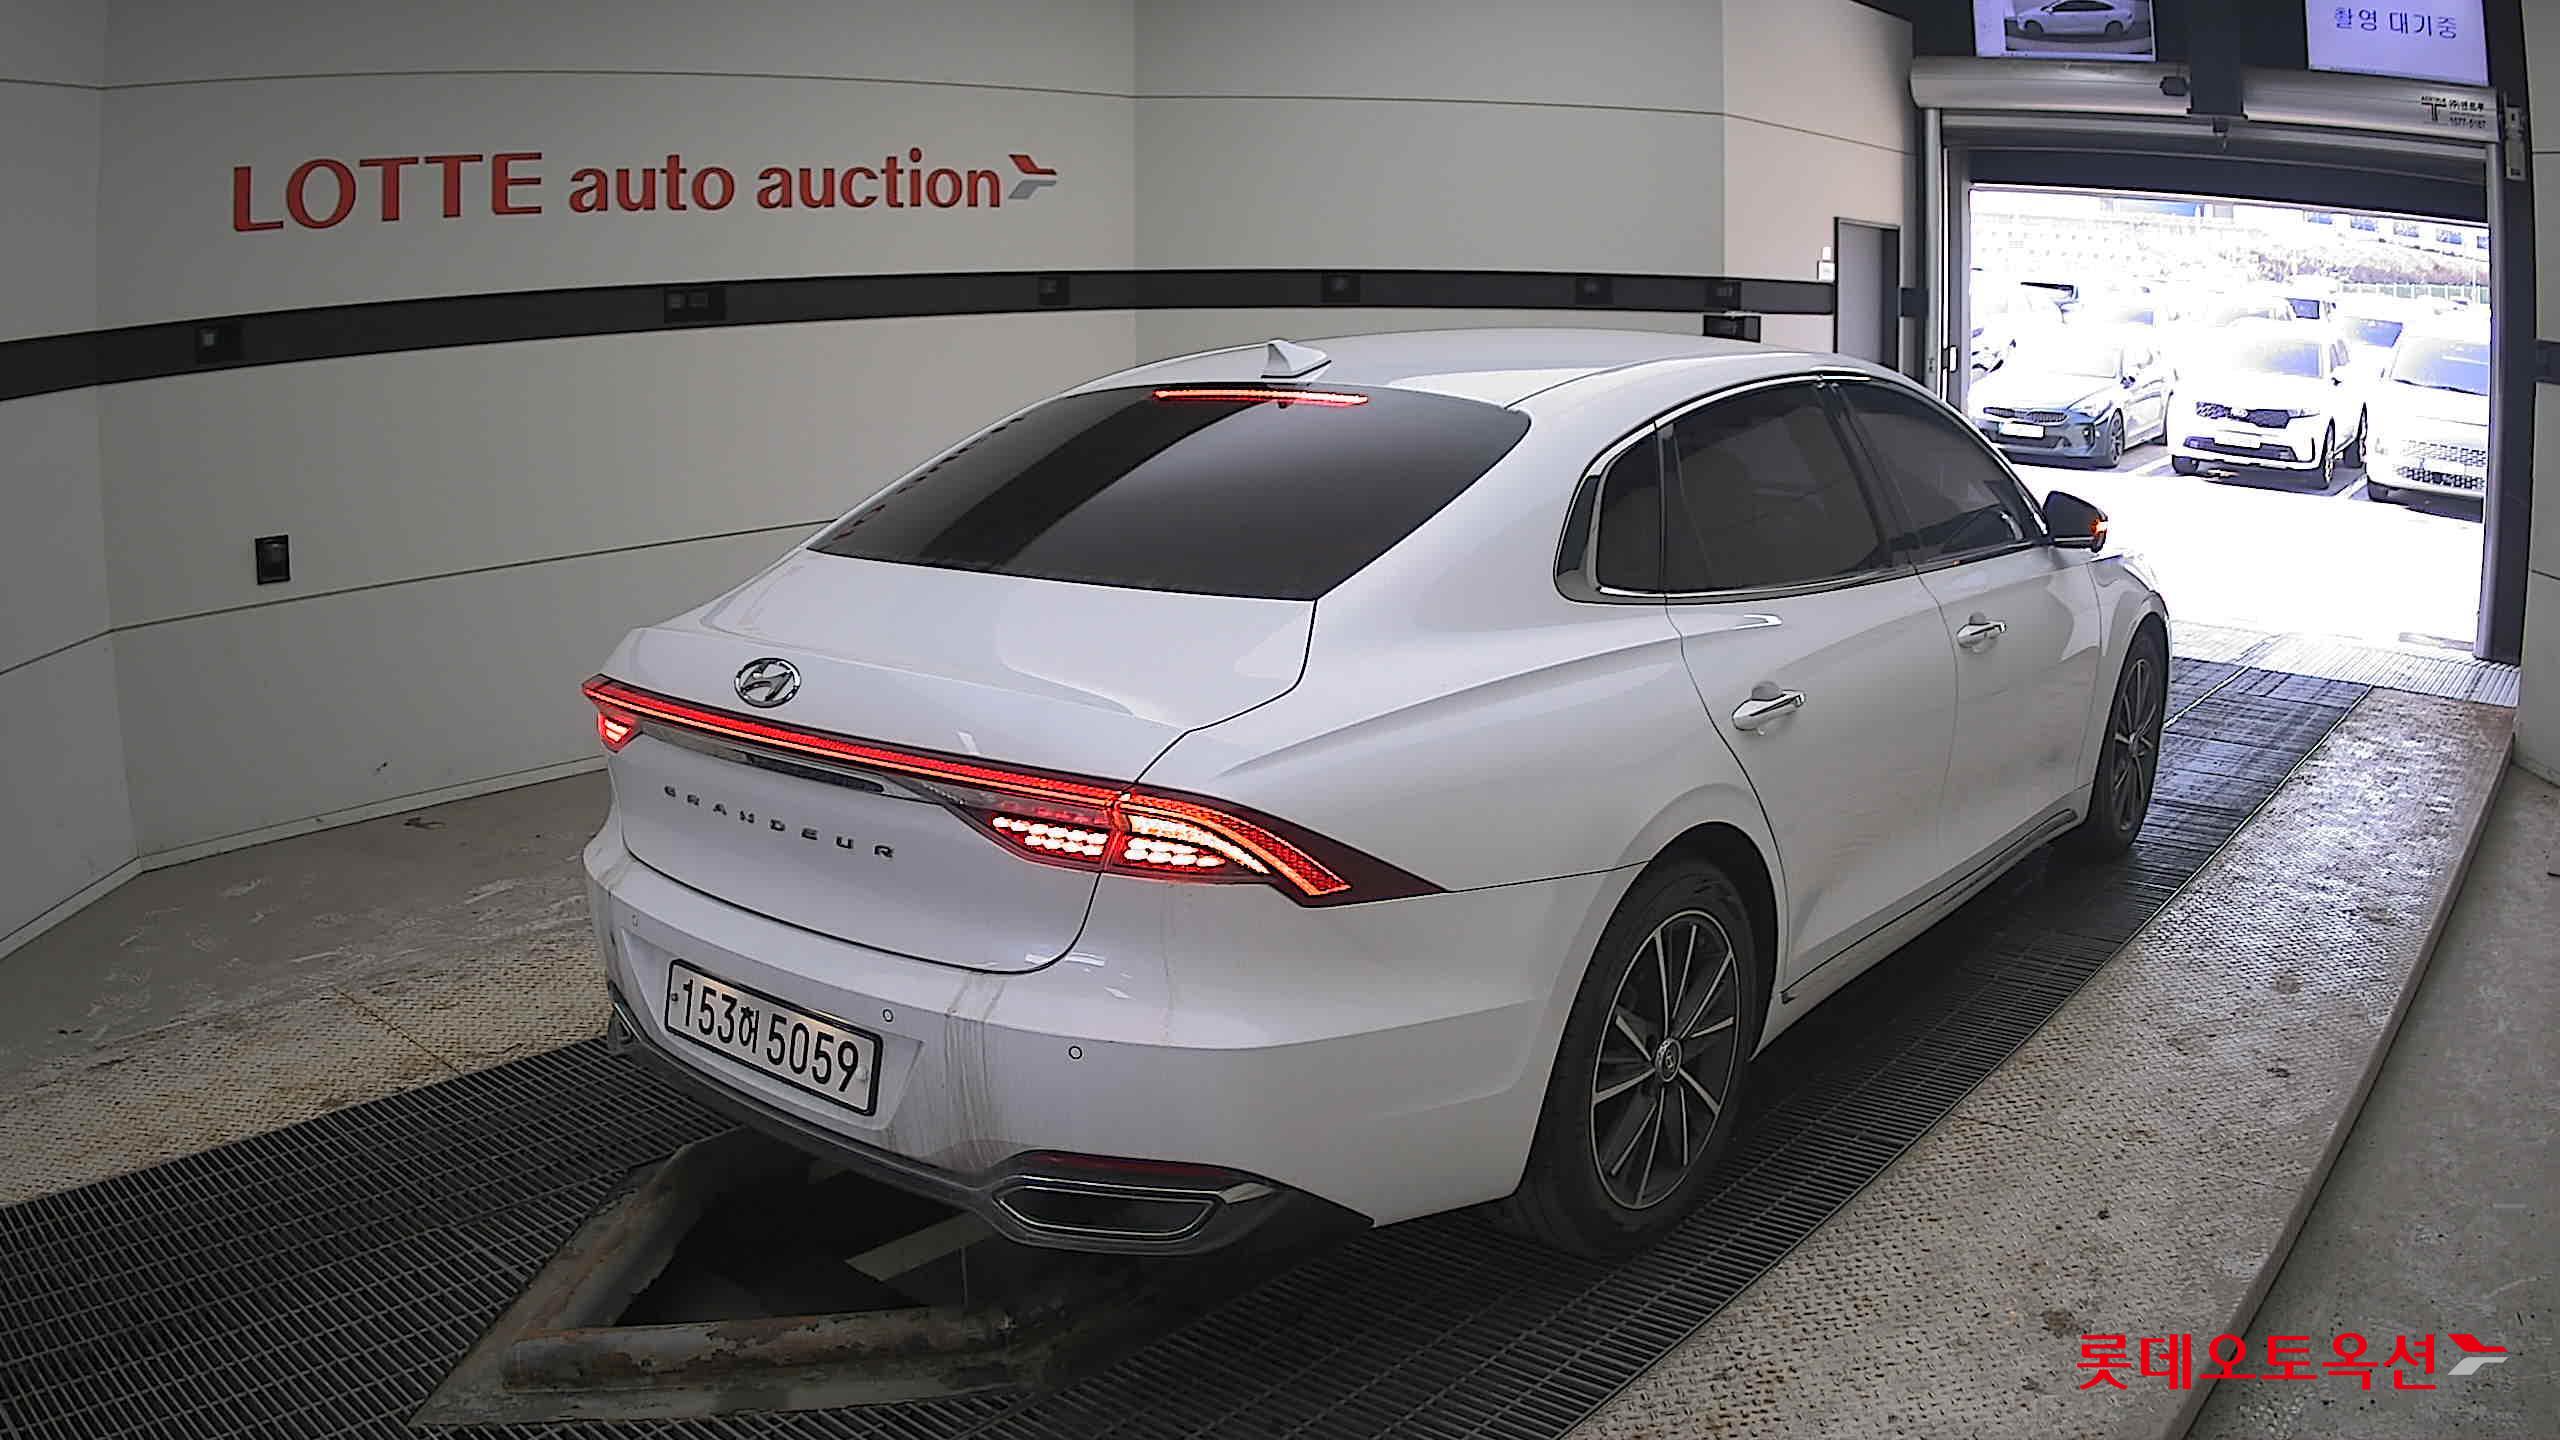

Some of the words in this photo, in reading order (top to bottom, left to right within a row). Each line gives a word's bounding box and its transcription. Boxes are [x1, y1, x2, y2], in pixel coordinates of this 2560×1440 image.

[232, 152, 543, 232] LOTTE
[568, 153, 735, 213] auto
[756, 147, 1001, 210] auction
[663, 784, 895, 859] GRANDEUR
[766, 1015, 860, 1093] 5059
